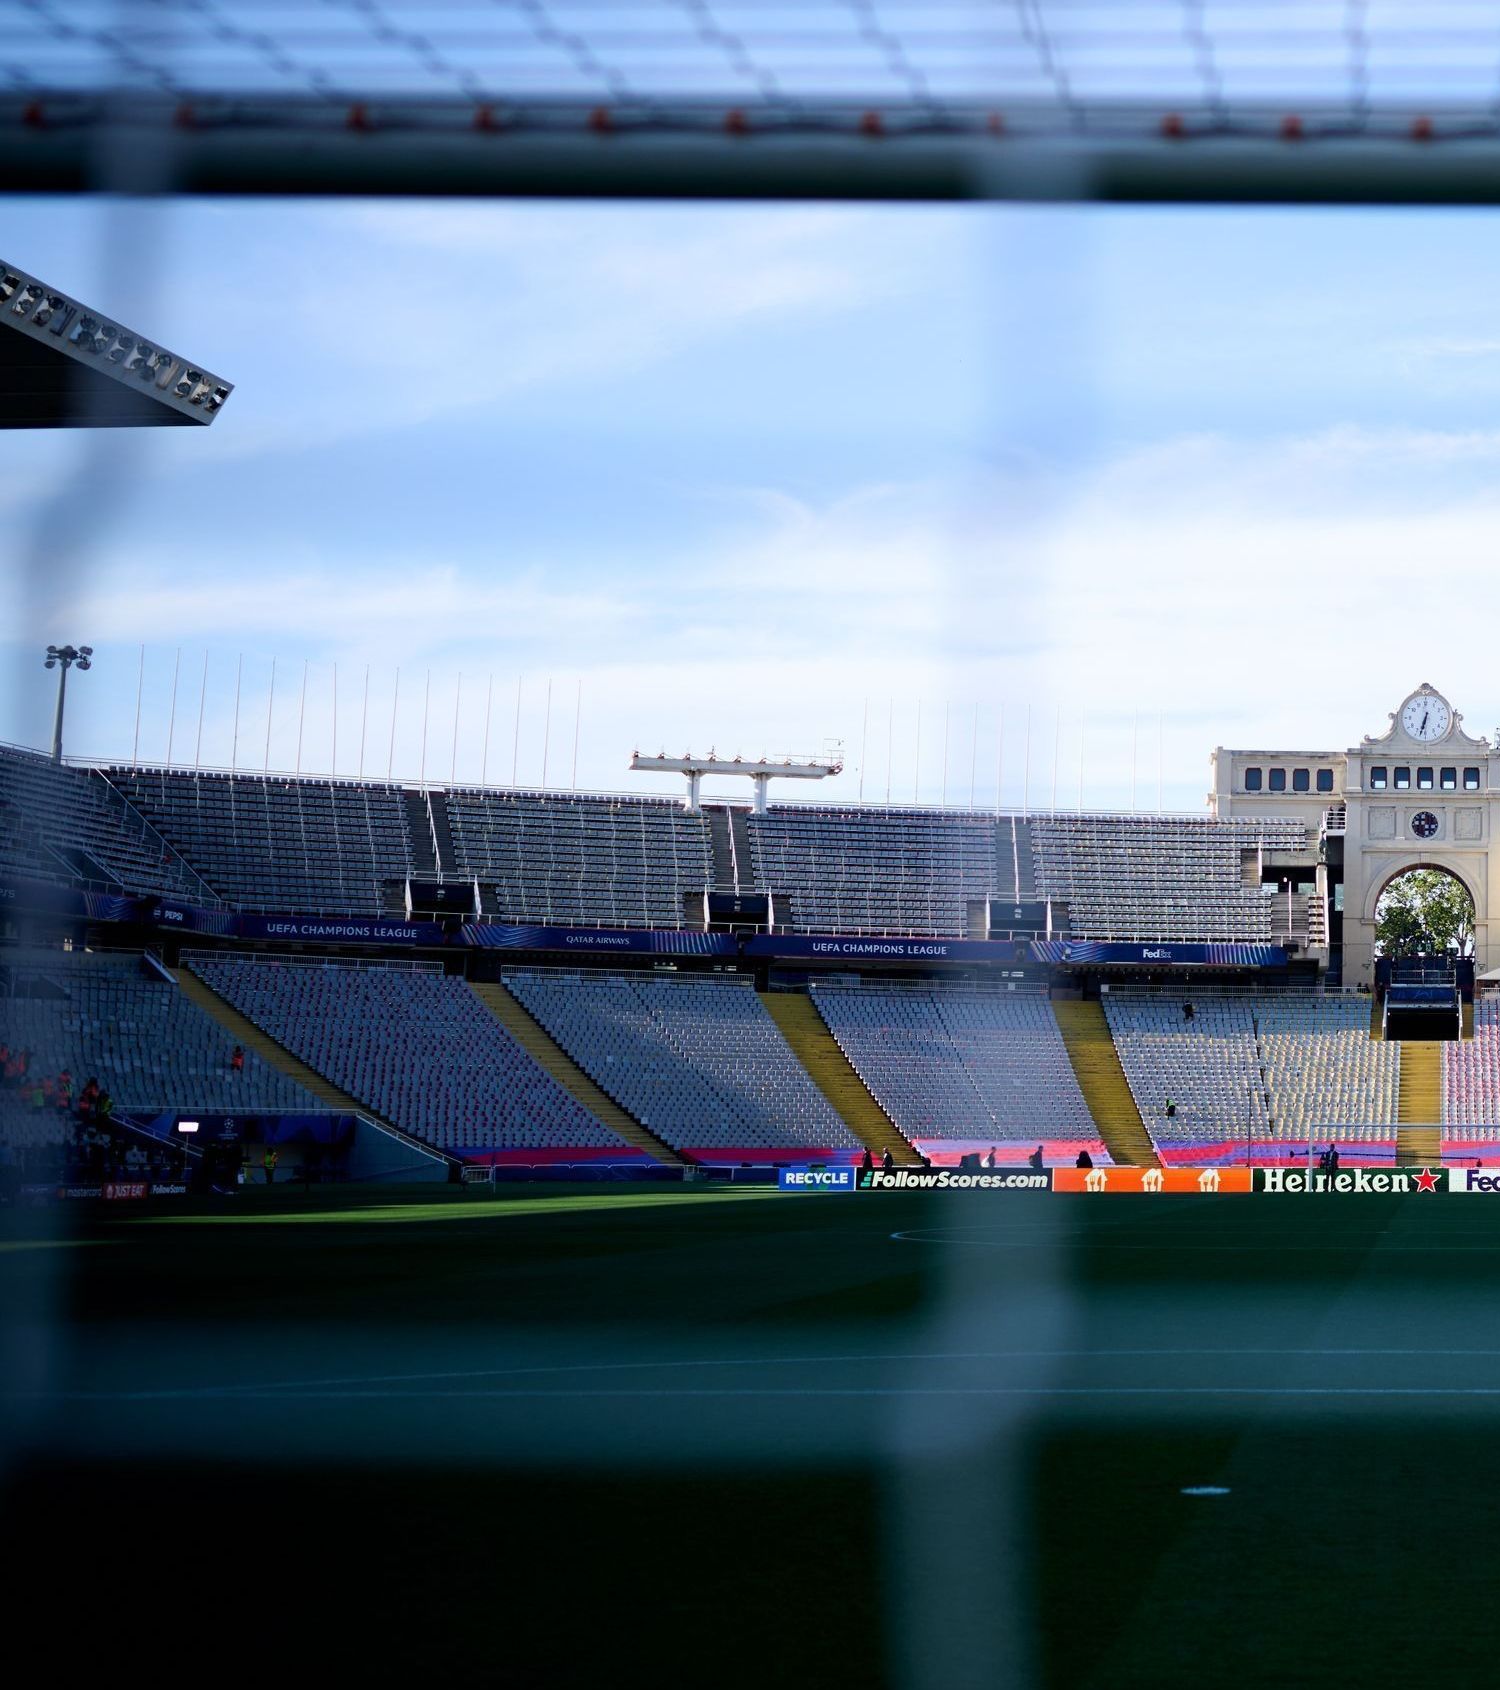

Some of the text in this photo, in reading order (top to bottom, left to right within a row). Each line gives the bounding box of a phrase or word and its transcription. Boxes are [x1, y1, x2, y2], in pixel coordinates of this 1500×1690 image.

[164, 910, 183, 921] PEPSI
[267, 923, 417, 938] UEFA CHAMPIONS LEAGUE
[566, 935, 630, 945] QATAR AIRWAYS
[812, 943, 947, 955] UEFA CHAMPIONS LEAGUE
[1142, 948, 1172, 958] FedEx
[785, 1172, 848, 1184] RECYCLE
[871, 1170, 1048, 1188] FollowScores.com
[1263, 1169, 1410, 1193] Heineken
[113, 1184, 144, 1198] JUST EAT
